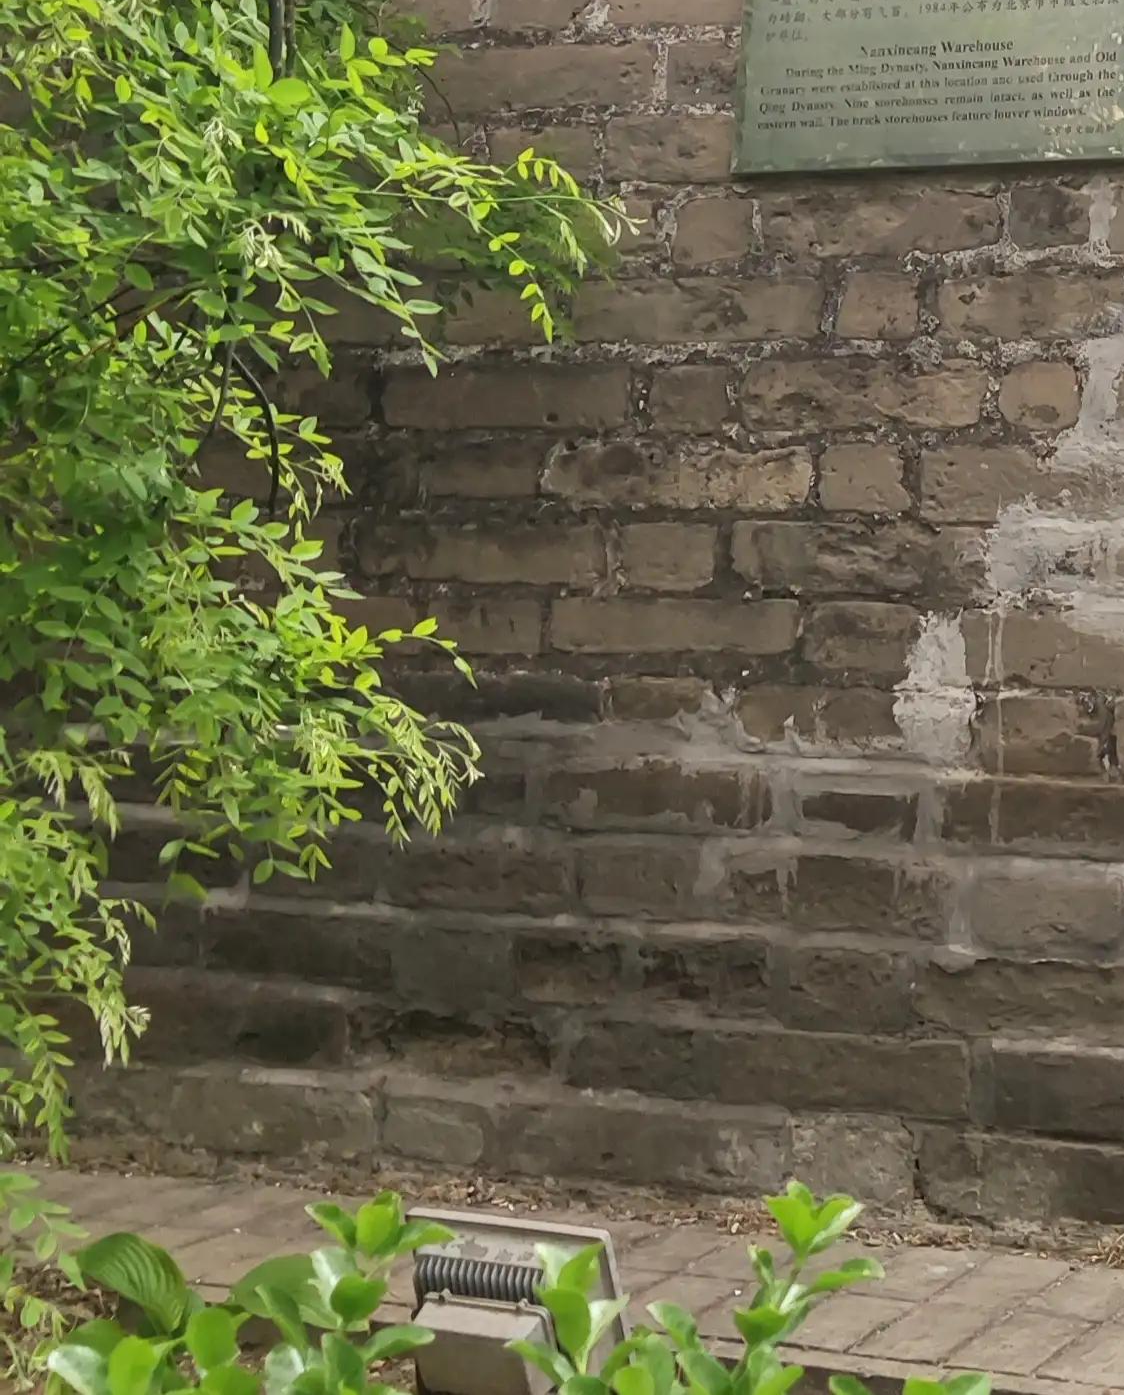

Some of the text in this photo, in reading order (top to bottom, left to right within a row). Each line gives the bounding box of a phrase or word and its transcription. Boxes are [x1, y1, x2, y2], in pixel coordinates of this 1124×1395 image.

[940, 39, 1014, 54] Warehouse
[785, 67, 824, 79] During
[827, 66, 844, 76] the
[847, 64, 877, 76] Ming
[932, 59, 999, 71] Nanxincang
[1002, 55, 1066, 67] Warehouse
[1069, 51, 1091, 64] and
[1095, 50, 1117, 63] Old
[811, 85, 835, 93] were
[839, 79, 901, 93] established
[904, 80, 915, 90] at
[919, 78, 940, 89] this
[944, 76, 988, 88] location
[992, 76, 1011, 85] and
[1018, 72, 1044, 85] used
[1048, 69, 1094, 84] through
[1098, 68, 1117, 81] the
[759, 102, 786, 115] Qing
[844, 98, 869, 109] Nine
[874, 96, 939, 108] storehouses
[944, 94, 984, 105] remain
[1031, 92, 1044, 101] as
[1050, 87, 1073, 100] well
[1078, 89, 1091, 99] as
[1097, 86, 1116, 99] the
[757, 120, 797, 130] eastern
[830, 116, 850, 127] The
[852, 114, 881, 126] brick
[884, 114, 949, 124] storehouses
[951, 111, 992, 122] feature
[994, 108, 1030, 120] louver
